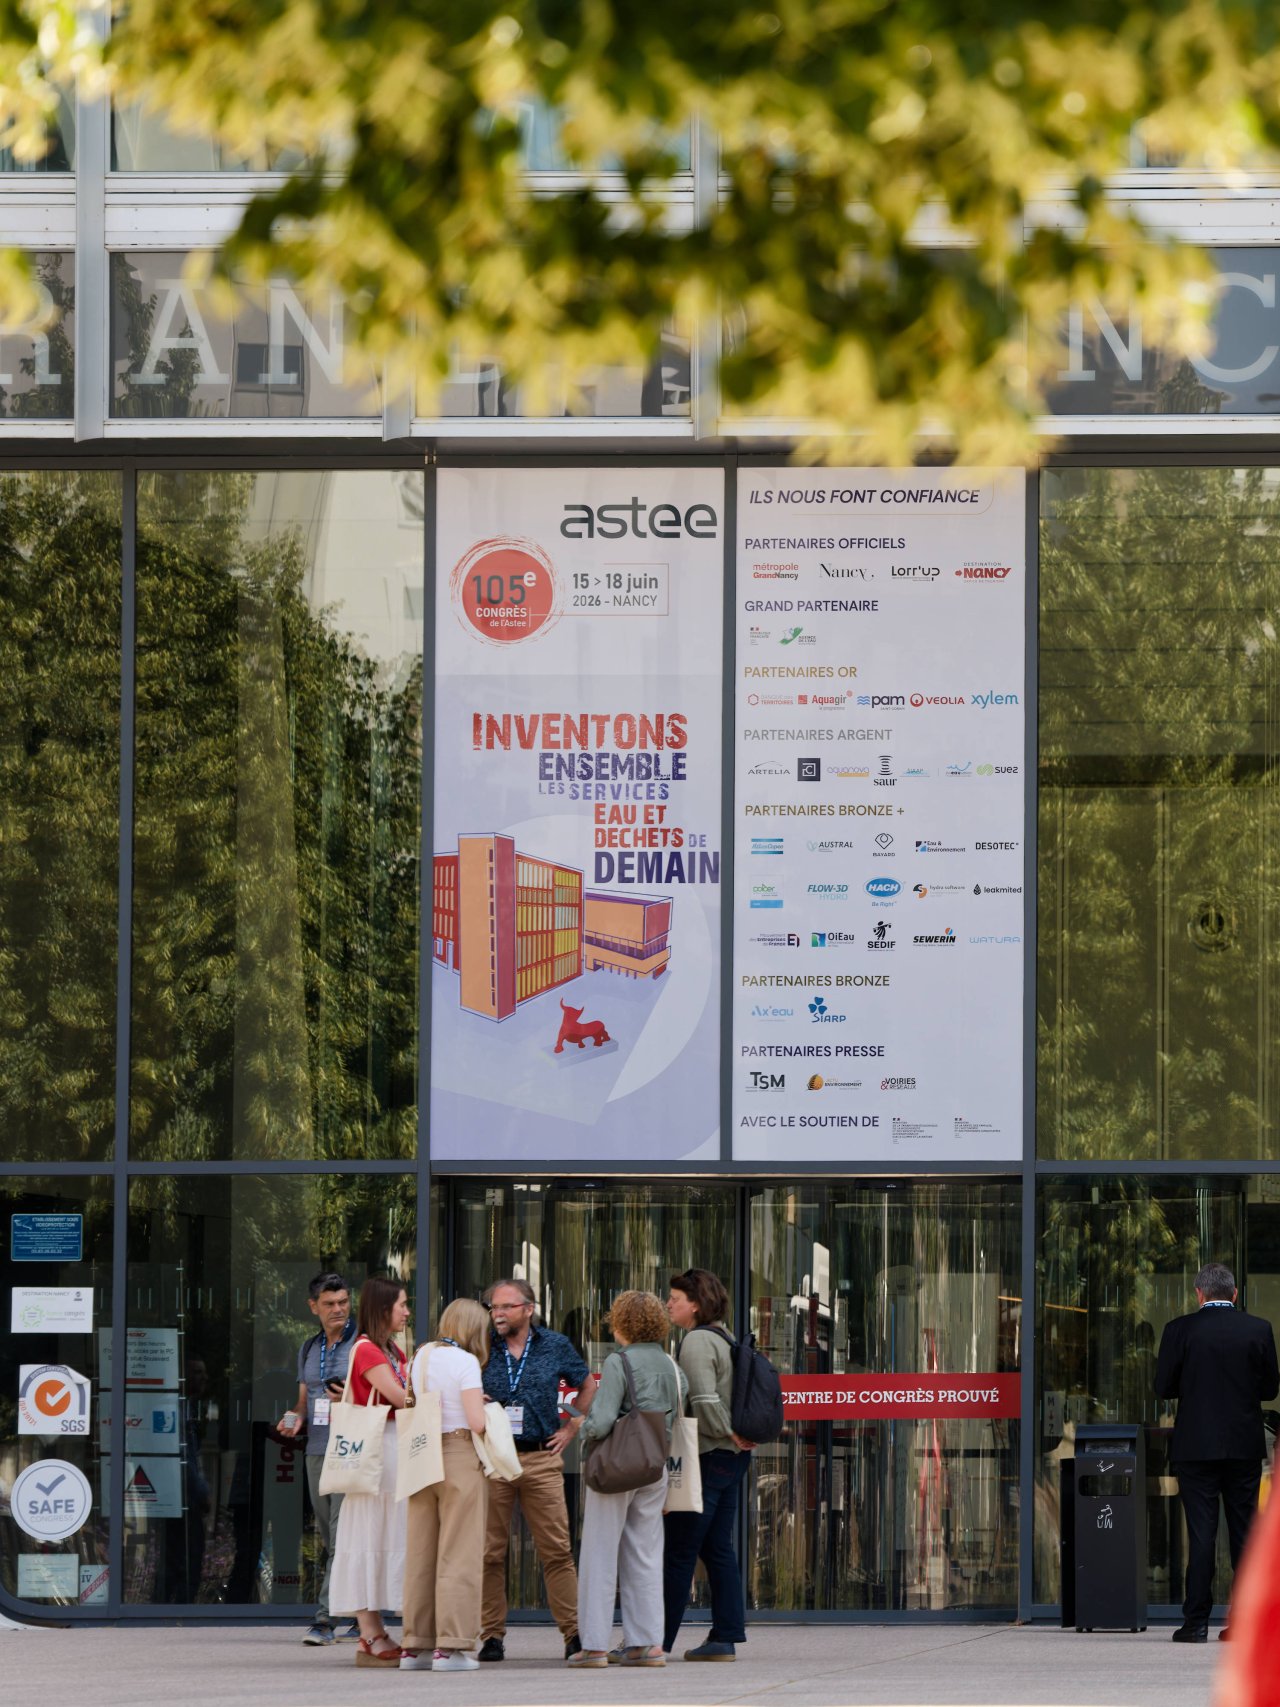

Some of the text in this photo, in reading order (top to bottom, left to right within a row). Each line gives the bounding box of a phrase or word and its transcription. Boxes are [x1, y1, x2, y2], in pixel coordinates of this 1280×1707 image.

[750, 489, 980, 504] ILS NOUS FONT CONFIANCE
[560, 497, 718, 539] astee
[745, 537, 906, 549] PARTENAIRES OFFICIELS
[753, 562, 799, 573] métropole
[573, 573, 589, 589] 15
[606, 573, 622, 589] 18
[626, 573, 658, 593] juin
[573, 595, 601, 607] 2026
[613, 595, 657, 607] NANCY
[745, 600, 879, 612] GRAND PARTENAIRE
[476, 605, 527, 618] CONGRÈS
[490, 619, 527, 627] de l'Astee
[744, 667, 857, 678] PARTENAIRES OR
[811, 694, 847, 706] Aquagir
[871, 695, 905, 708] pam
[971, 690, 1019, 709] xylem
[473, 712, 688, 750] INVENTONS
[744, 729, 893, 741] PARTENAIRES ARGENT
[538, 752, 687, 781] ENSEMBLE
[995, 766, 1019, 774] suez
[873, 778, 897, 786] saur
[538, 782, 669, 800] LES SERVICES
[594, 803, 667, 825] EAU ET
[745, 805, 835, 816] PARTENAIRES
[838, 805, 893, 816] BRONZE
[594, 827, 706, 848] DECHETS DE
[594, 851, 720, 884] DEMAIN
[807, 884, 848, 893] FLOW-3D
[868, 883, 899, 892] HACH
[984, 886, 1022, 894] leakmited
[828, 932, 854, 941] OiEau
[913, 935, 956, 943] SEWERIN
[969, 936, 1020, 944] WATURA
[867, 941, 896, 949] SEDIF
[742, 975, 890, 987] PARTENAIRES BRONZE
[742, 1046, 885, 1057] PARTENAIRES PRESSE
[749, 1072, 785, 1089] TSM
[885, 1077, 916, 1085] VOIRIES
[740, 1116, 880, 1127] AVEC LE SOUTIEN DE
[836, 1391, 855, 1404] DE
[859, 1388, 934, 1403] CONGRÈS
[938, 1387, 999, 1403] PROUVÉ
[61, 1419, 86, 1433] SGS
[335, 1434, 364, 1456] TSM
[28, 1499, 75, 1515] SAFE
[30, 1514, 74, 1522] CONGRESS
